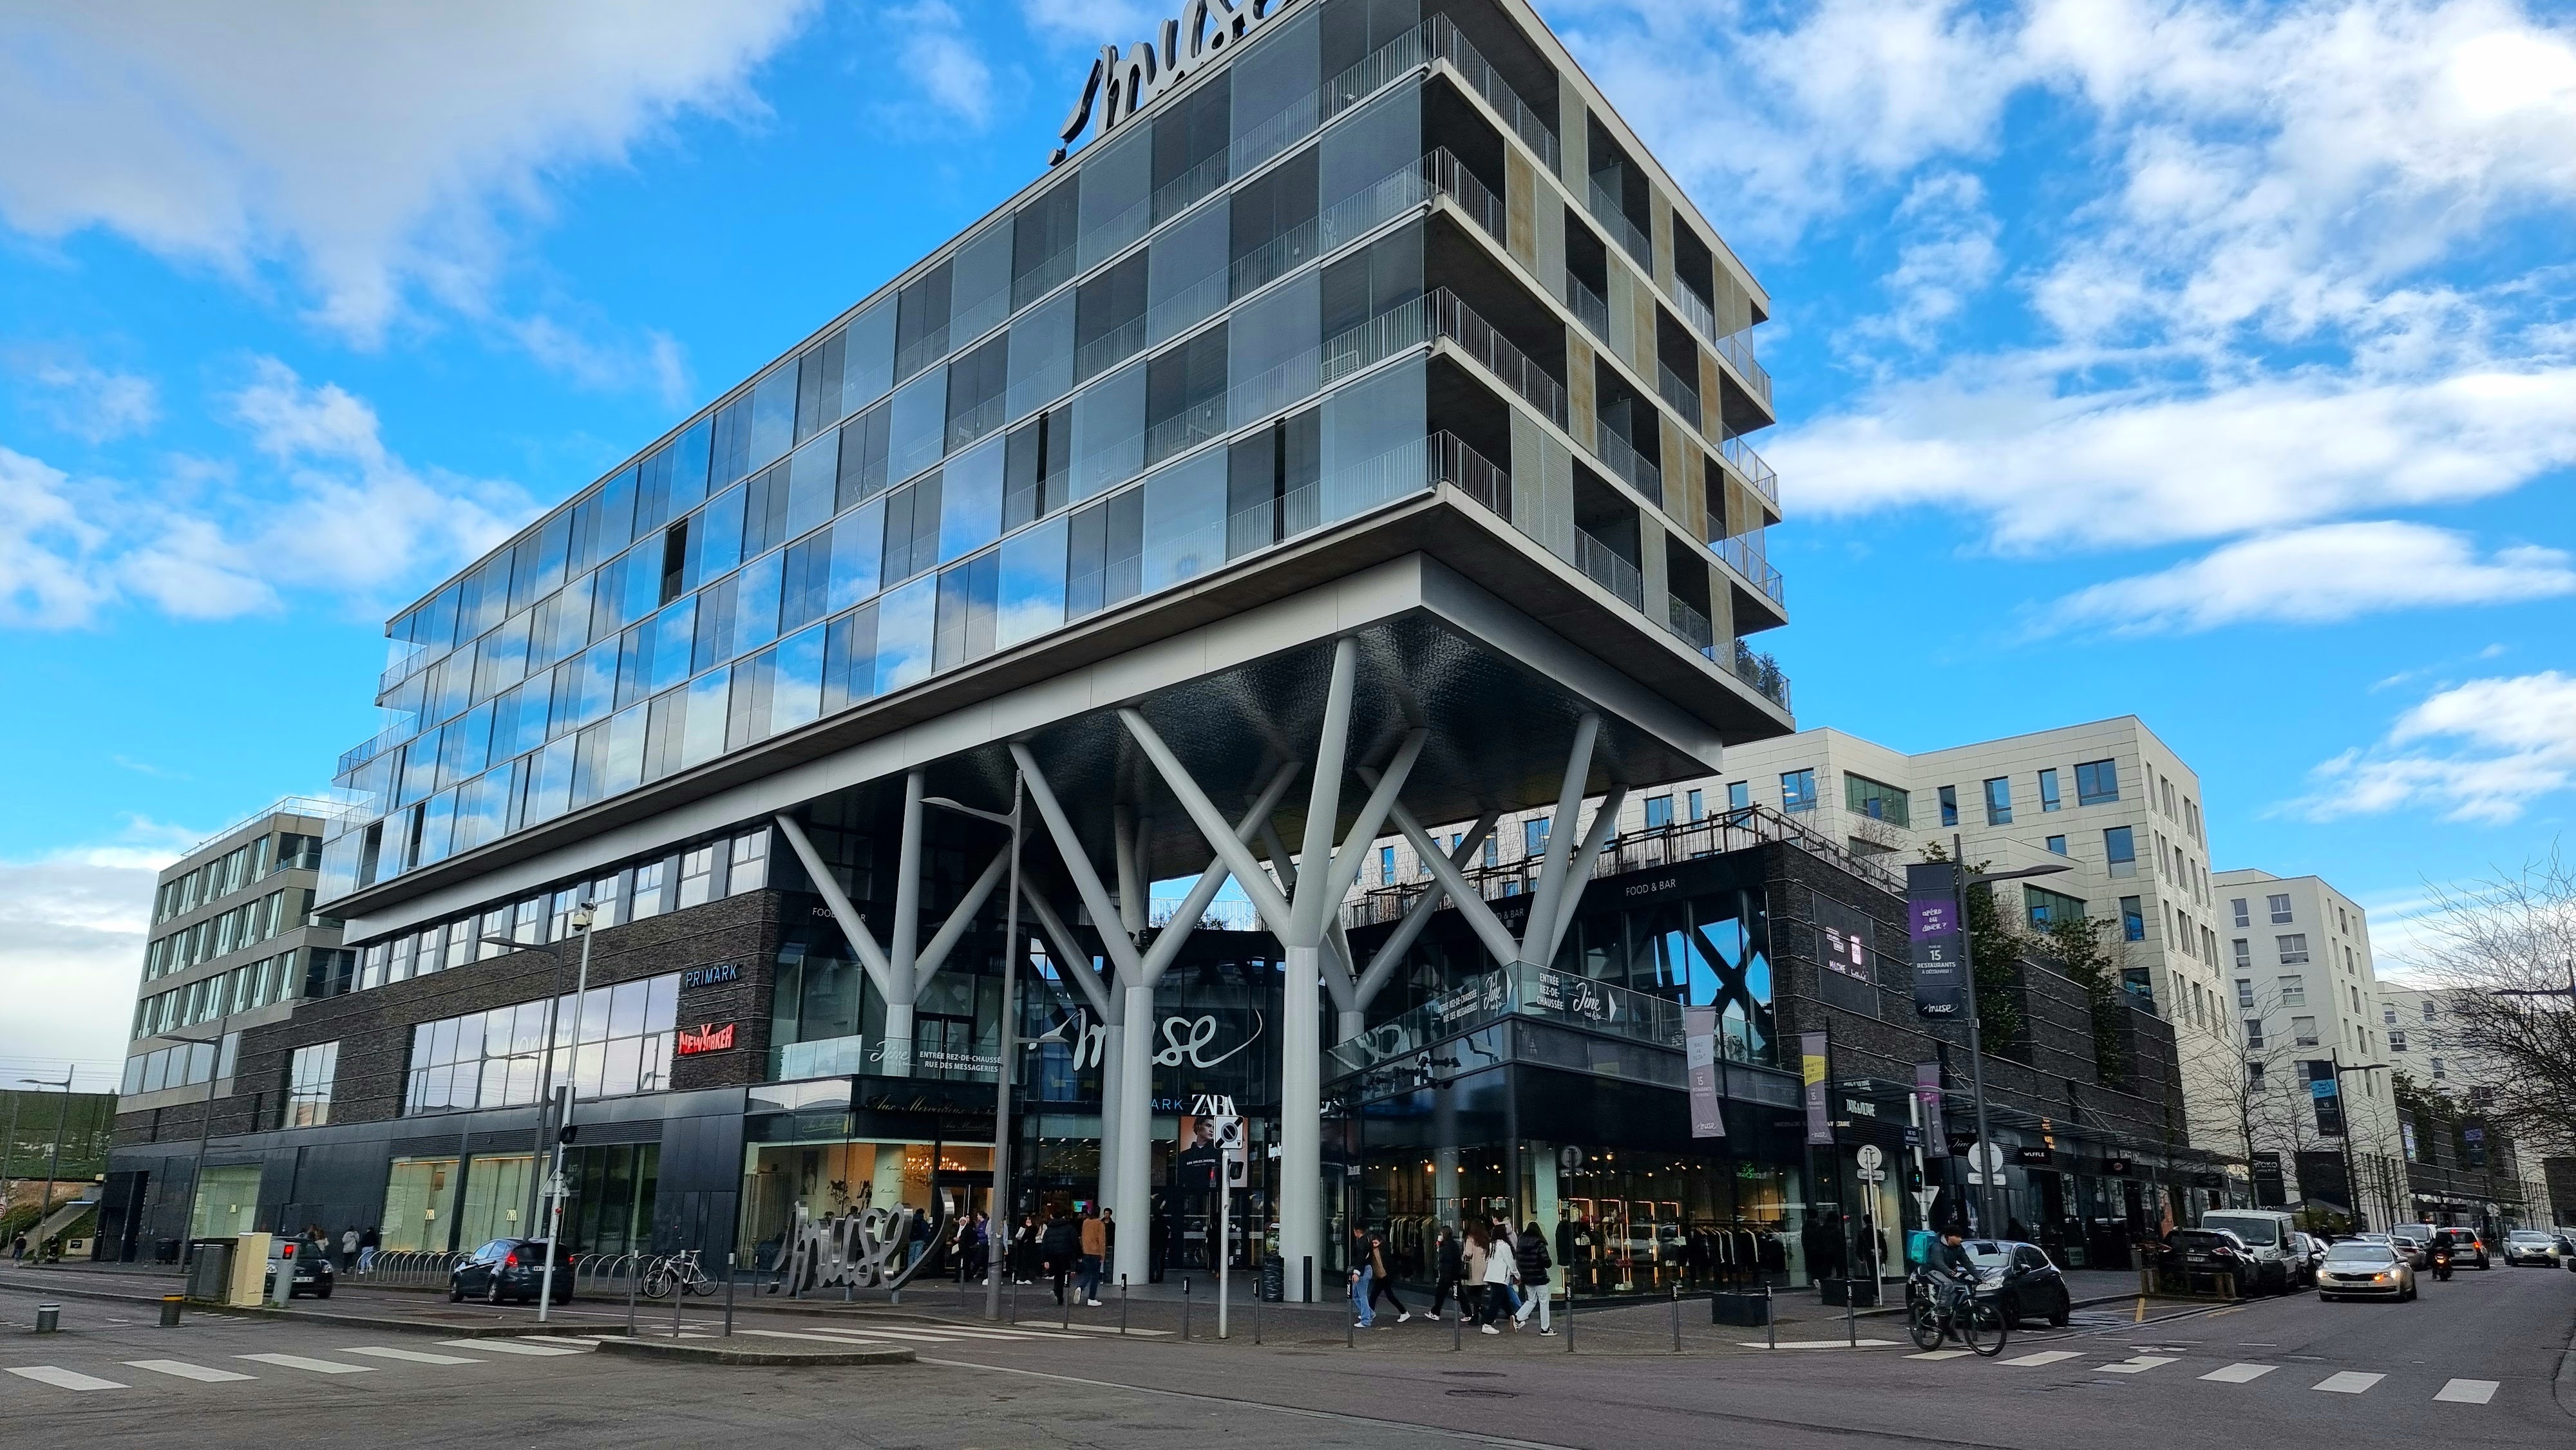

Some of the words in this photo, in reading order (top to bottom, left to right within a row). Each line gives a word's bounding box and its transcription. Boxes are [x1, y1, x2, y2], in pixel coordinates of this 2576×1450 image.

[1626, 886, 1649, 896] FOOD
[1651, 883, 1657, 891] &
[1660, 879, 1676, 890] BAR
[1510, 909, 1524, 918] BAR
[1929, 950, 1942, 961] 15
[686, 964, 737, 988] PRIMARK
[1539, 972, 1559, 986] ENTRÉE
[1539, 984, 1560, 997] REZ-DE-
[1573, 982, 1601, 1012] Jine
[1536, 995, 1564, 1010] CHAUSSÉE
[1922, 1003, 1958, 1013] muse
[1028, 1008, 1262, 1071] mse
[920, 1051, 945, 1060] ENTRÉE
[946, 1053, 1001, 1064] REZ-DE-CHAUSSÉ
[954, 1063, 998, 1073] MESSAGERIES
[1191, 1095, 1237, 1115] ZARA
[766, 1187, 954, 1297] muse
